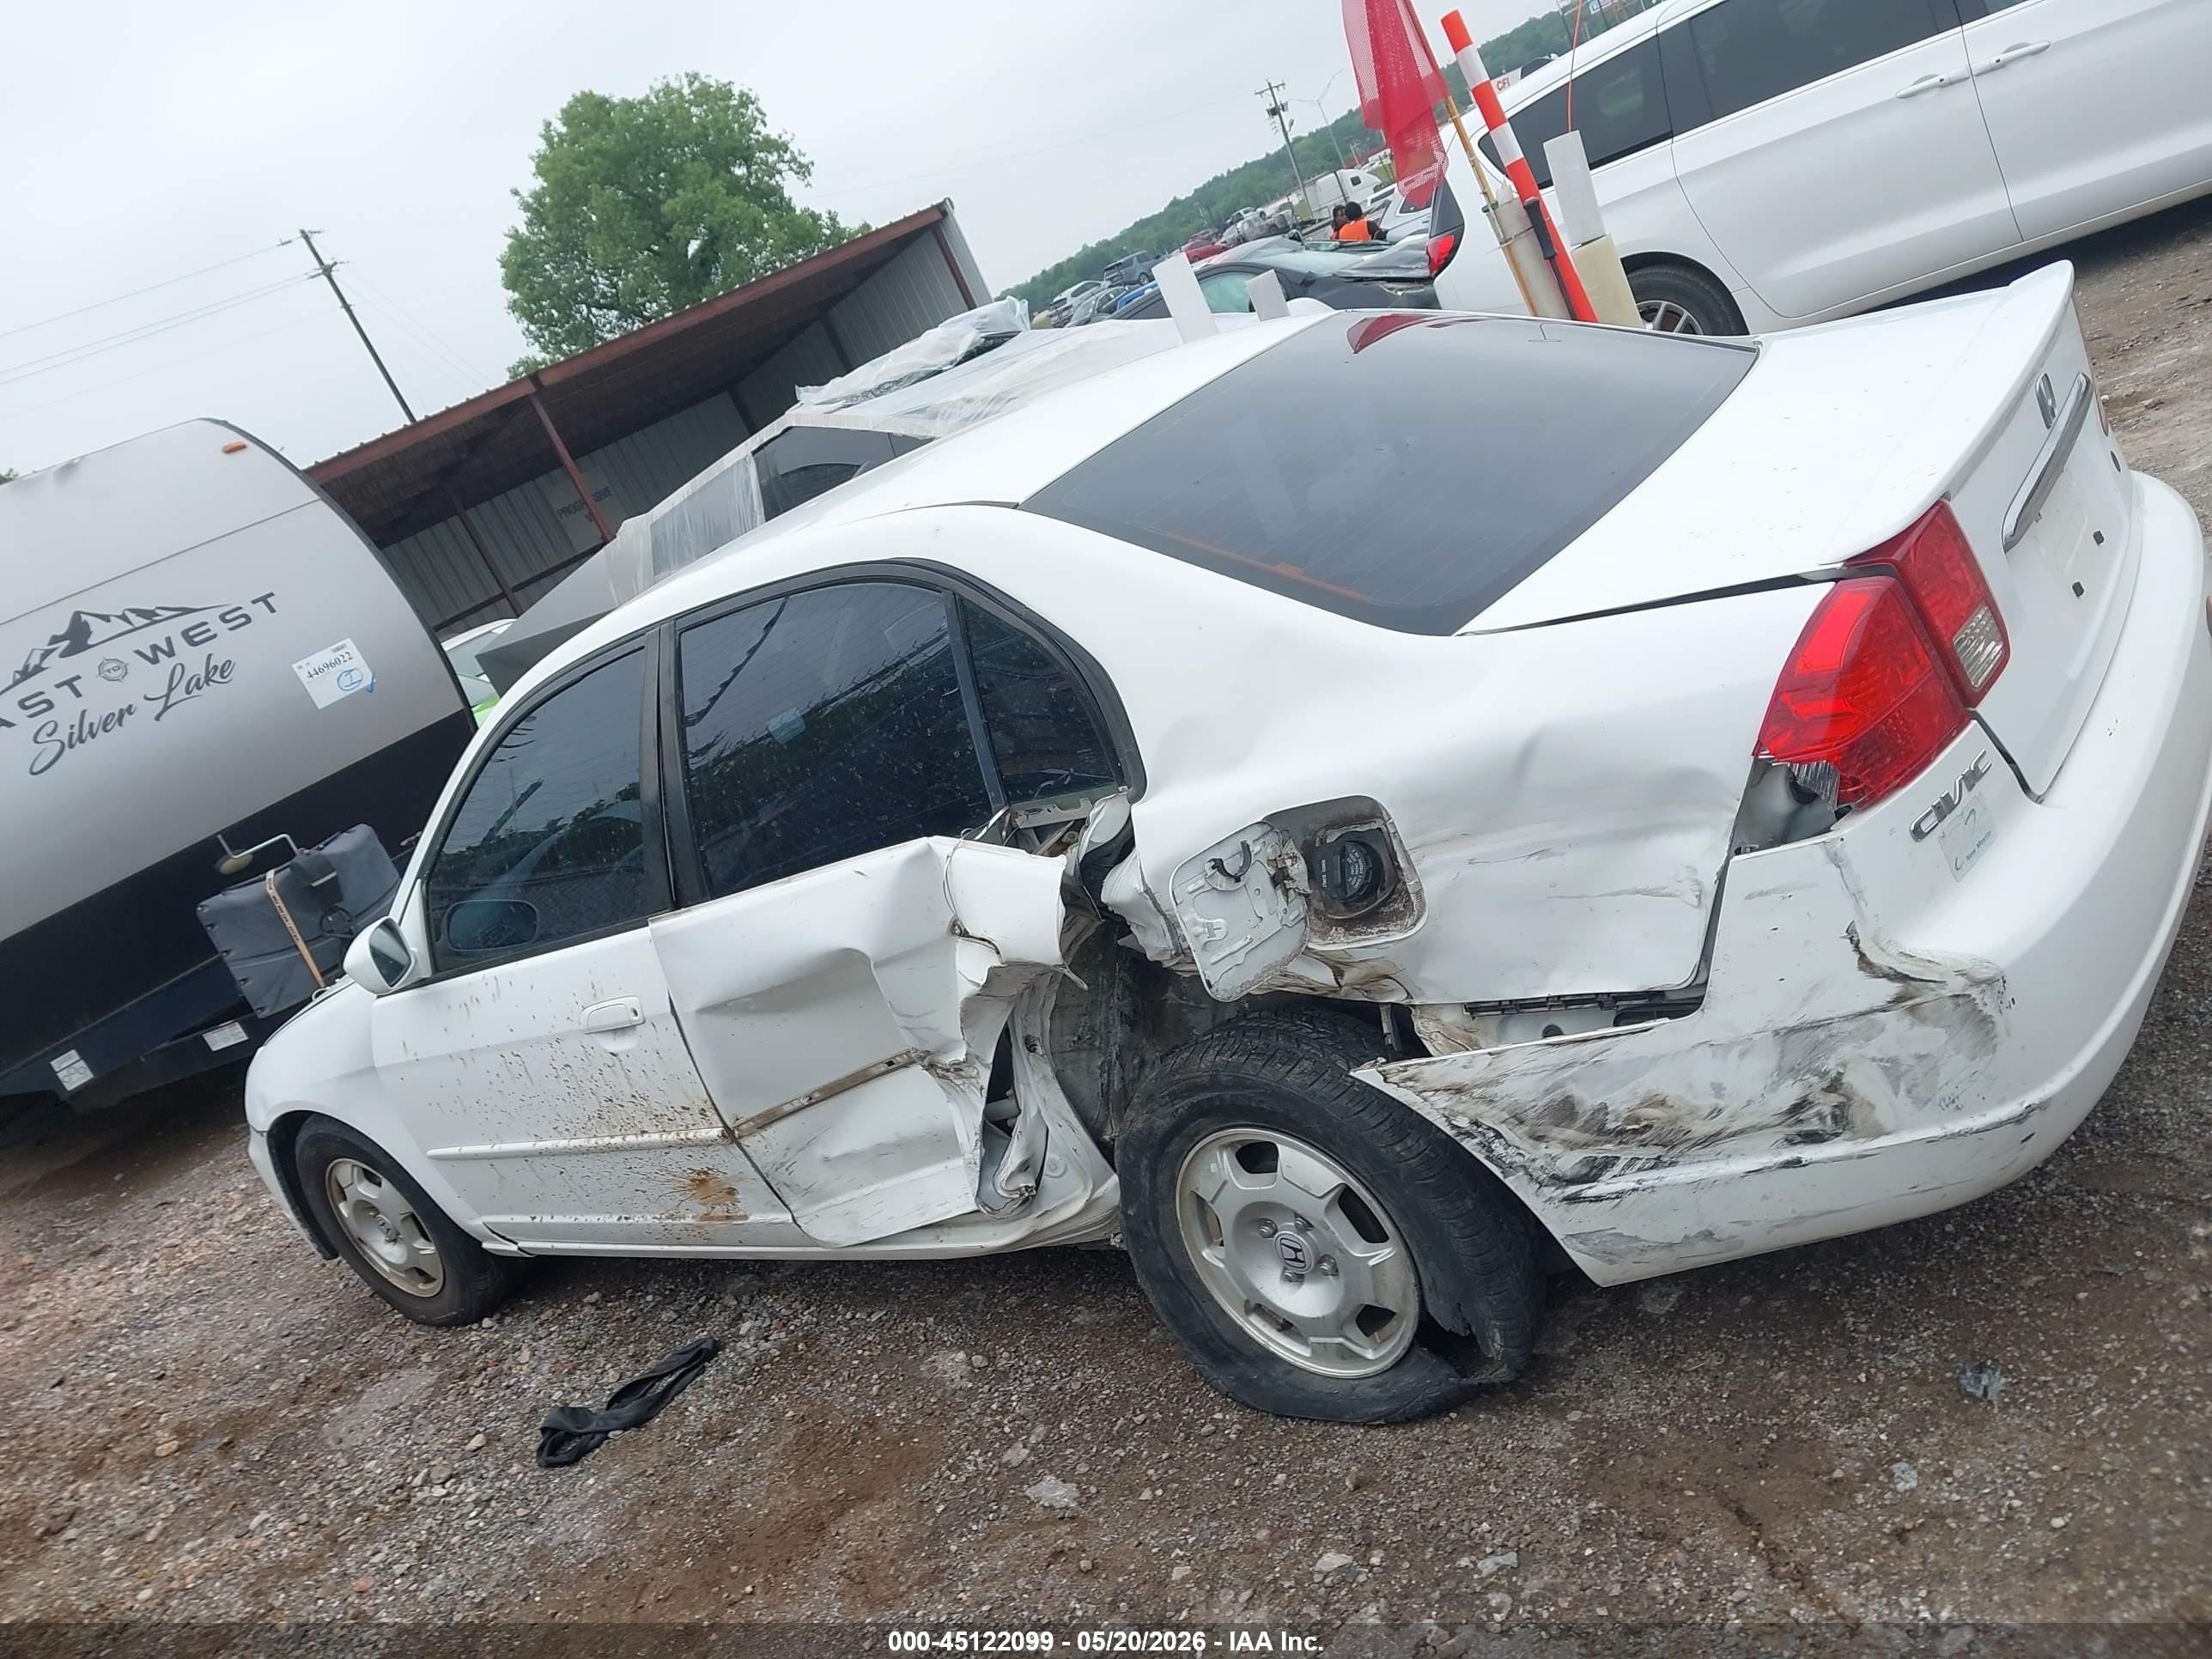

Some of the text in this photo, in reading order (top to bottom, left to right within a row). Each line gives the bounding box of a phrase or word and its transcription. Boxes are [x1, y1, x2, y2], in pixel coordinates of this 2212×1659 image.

[133, 592, 276, 665] WEST
[307, 651, 354, 679] 44696022
[28, 653, 236, 775] Silver Lake
[1909, 749, 1992, 842] CIVIC
